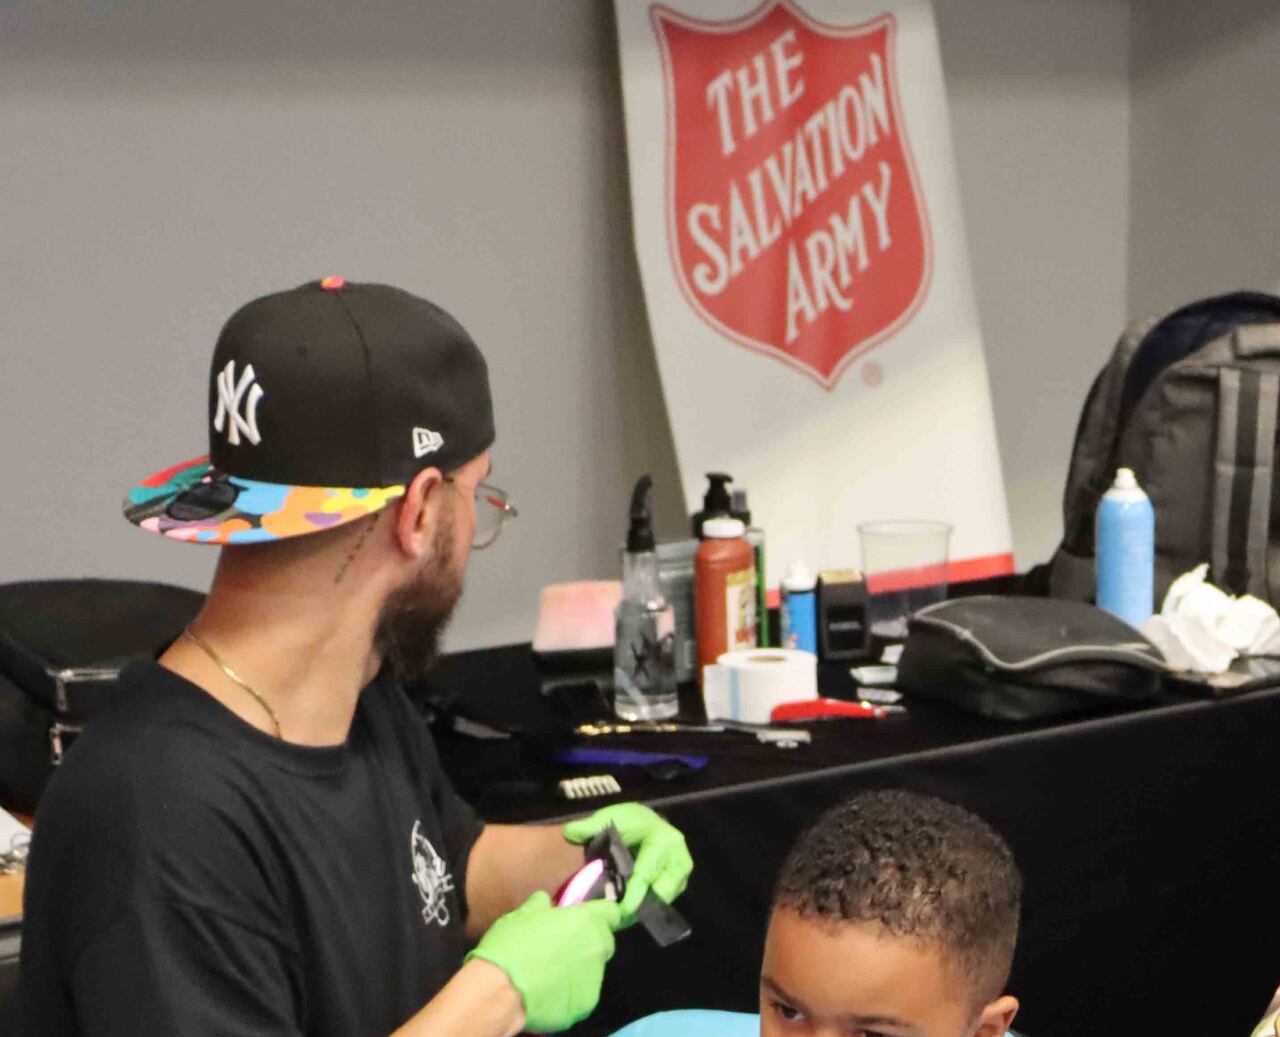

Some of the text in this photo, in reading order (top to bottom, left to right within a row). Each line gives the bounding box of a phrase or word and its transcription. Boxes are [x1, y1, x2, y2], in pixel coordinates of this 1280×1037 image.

[706, 30, 805, 156] THE
[686, 52, 891, 296] SALVATION
[785, 161, 893, 345] ARMY
[213, 359, 264, 446] NY
